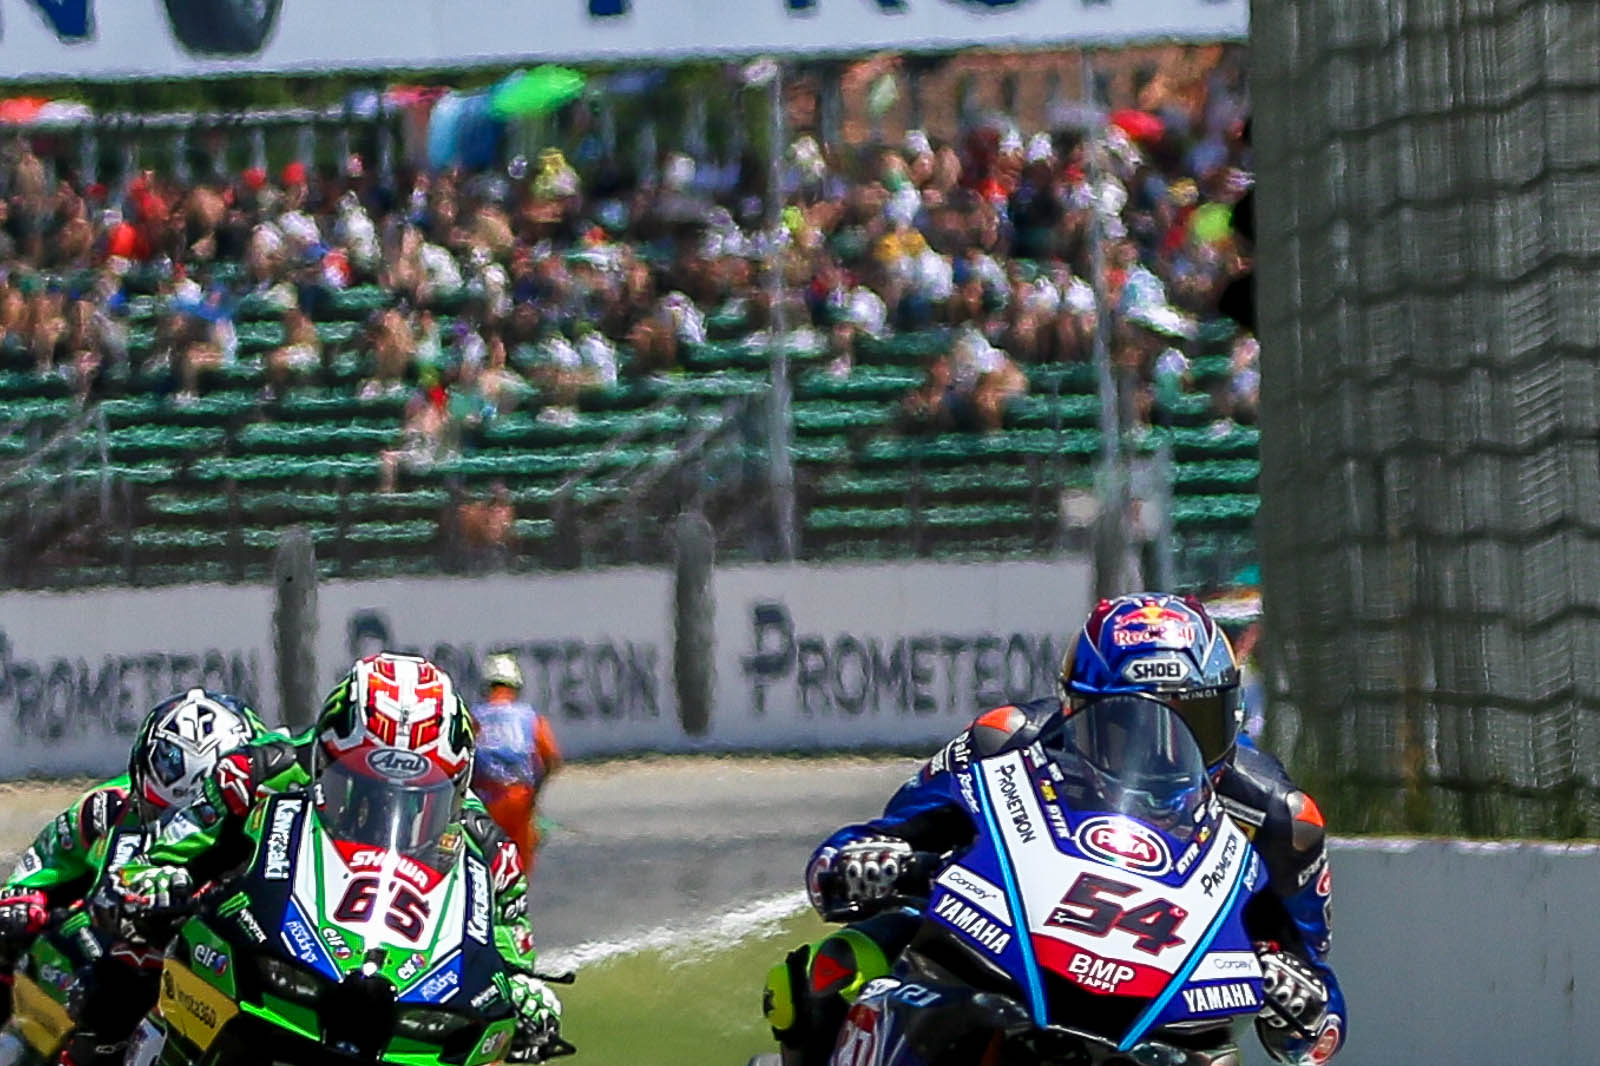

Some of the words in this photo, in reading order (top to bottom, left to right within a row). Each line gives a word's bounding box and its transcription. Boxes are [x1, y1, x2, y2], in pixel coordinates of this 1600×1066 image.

[1132, 664, 1181, 679] SHOEI
[374, 751, 421, 771] Arai
[995, 763, 1037, 845] PROMETEON
[264, 799, 303, 880] Kawasaki
[1092, 828, 1152, 860] PTA
[350, 850, 429, 889] SHWA
[948, 871, 993, 900] Corpay
[333, 876, 432, 943] 65
[934, 893, 1012, 955] YAMAHA
[1043, 872, 1188, 957] 54
[322, 927, 342, 947] elf
[194, 944, 217, 968] elf
[1068, 952, 1136, 985] BMP
[1076, 974, 1117, 994] TAPPI
[1182, 983, 1257, 1013] YAMAHA
